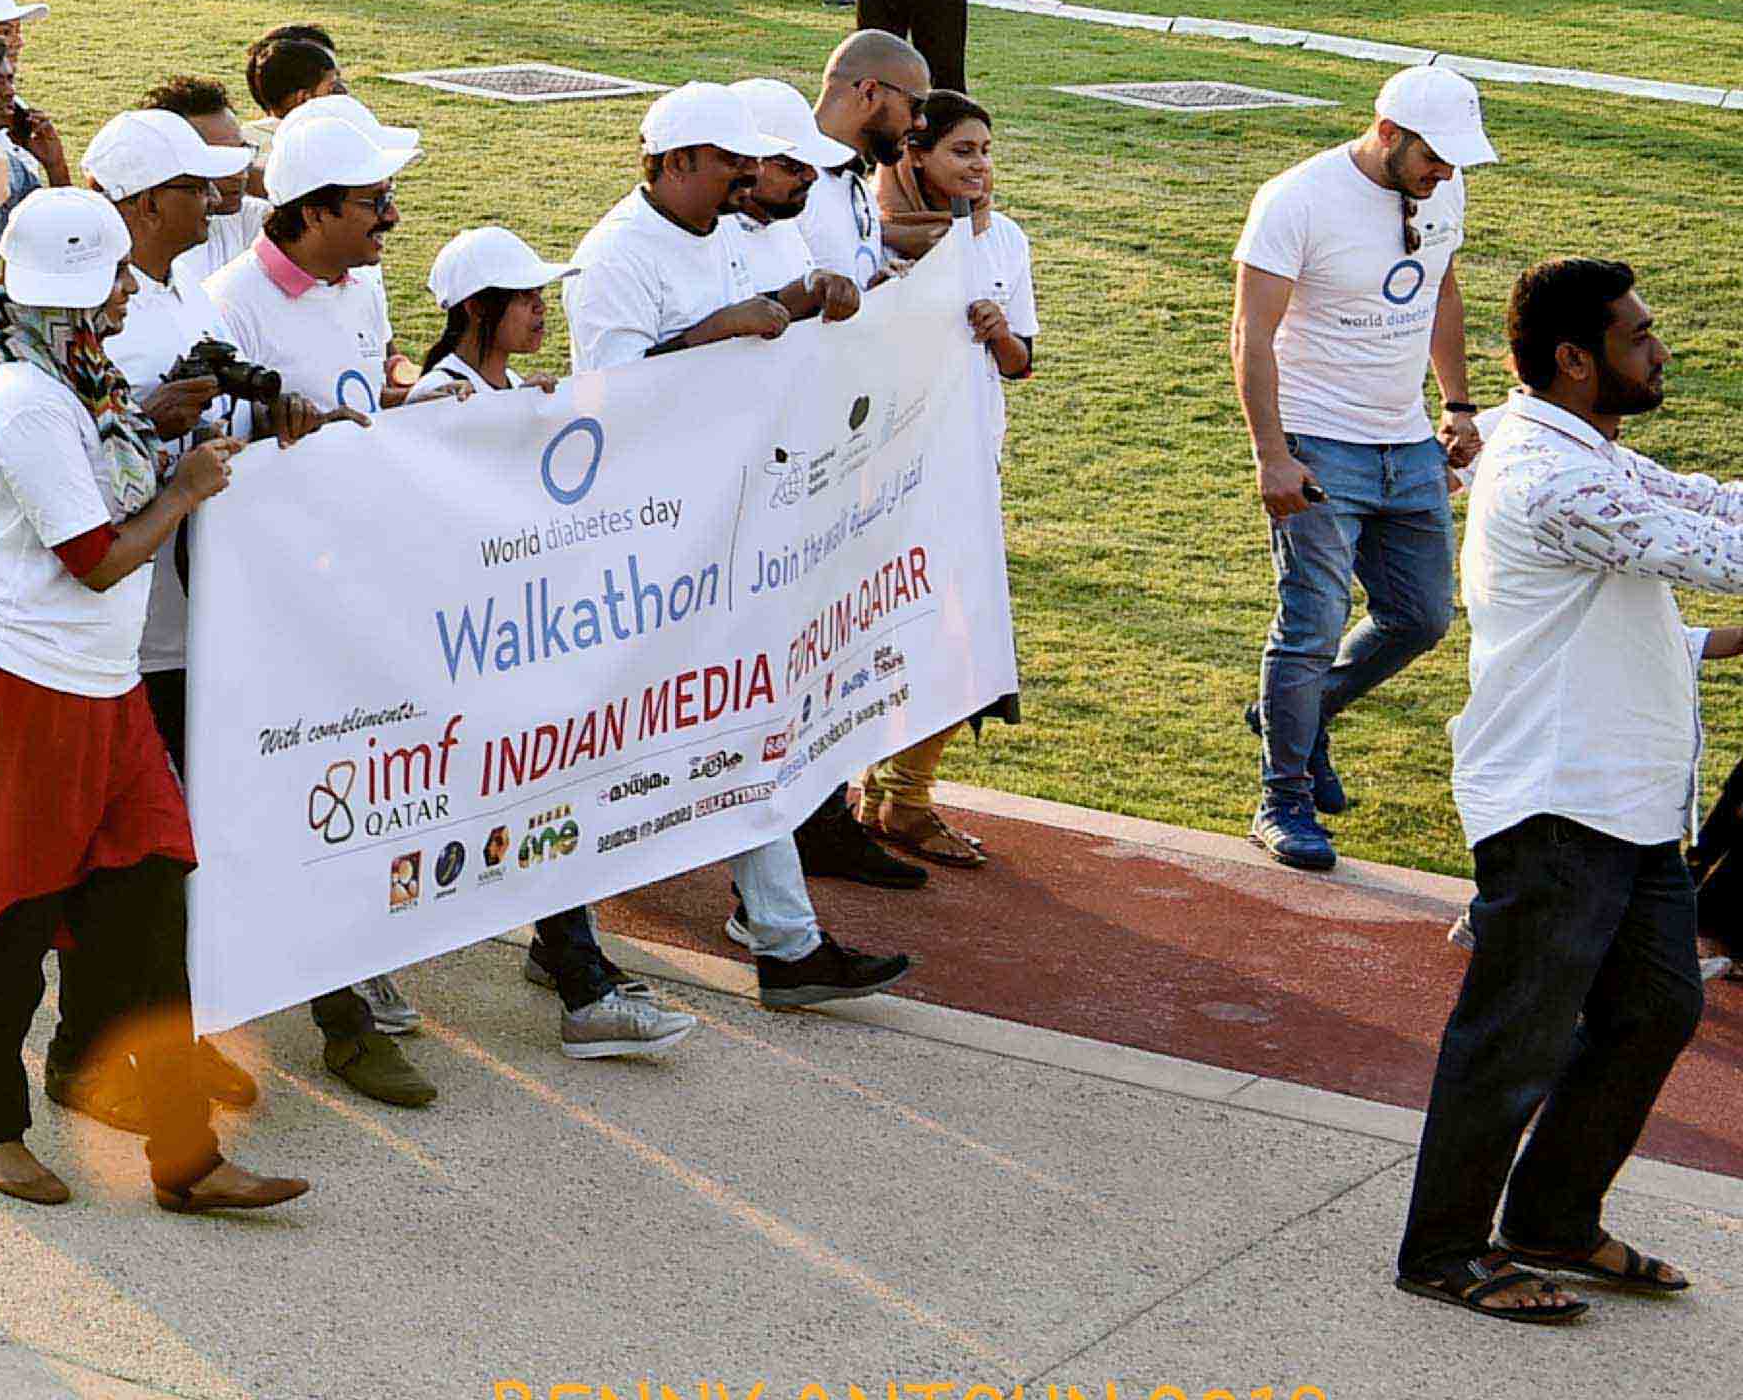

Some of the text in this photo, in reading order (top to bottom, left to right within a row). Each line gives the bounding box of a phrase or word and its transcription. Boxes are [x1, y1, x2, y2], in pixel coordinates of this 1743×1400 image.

[481, 496, 683, 567] World diabetes day
[751, 545, 799, 594] Join
[435, 554, 720, 684] Walkathon
[481, 696, 628, 796] INDIAN
[638, 652, 775, 741] MEDIA
[785, 545, 932, 696] FORUM-QATAR
[259, 717, 302, 756] With
[367, 714, 464, 805] imf
[365, 794, 450, 836] QATAR
